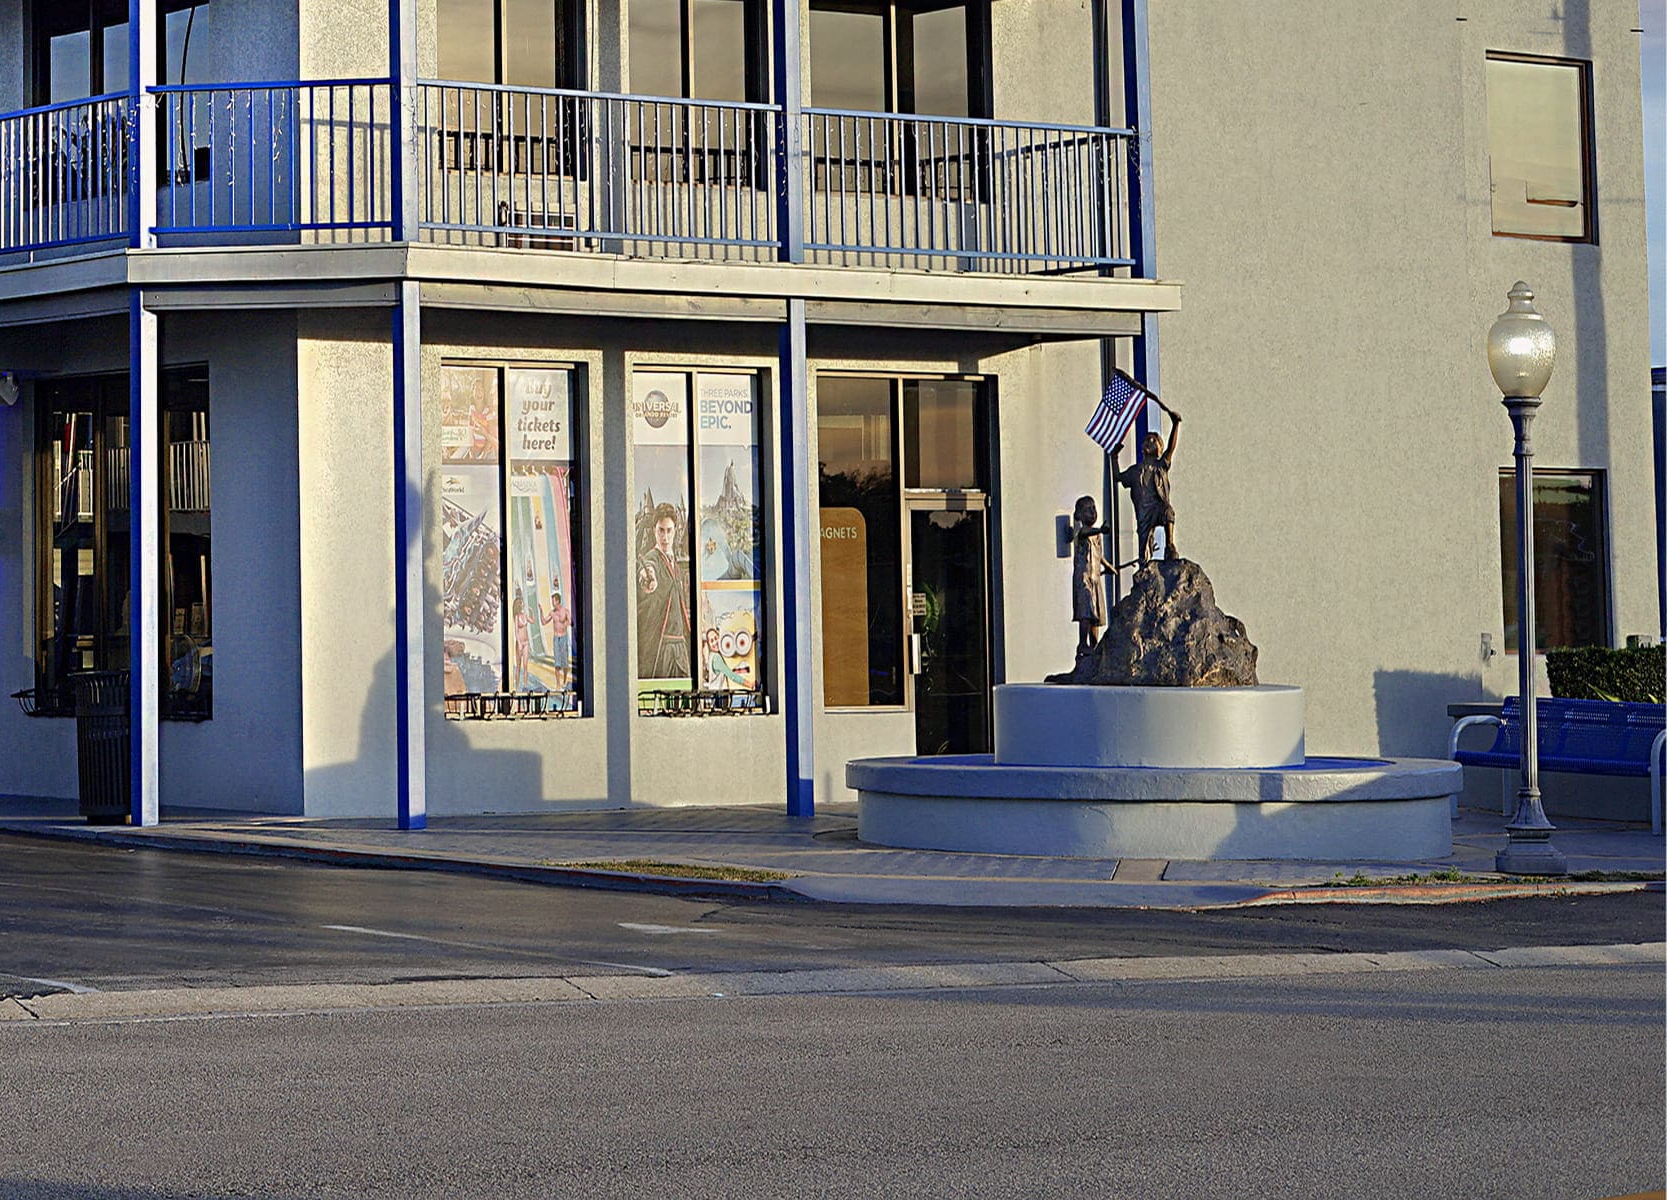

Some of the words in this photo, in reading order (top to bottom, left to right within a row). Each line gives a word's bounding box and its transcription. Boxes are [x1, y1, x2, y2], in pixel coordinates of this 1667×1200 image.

[522, 400, 555, 415] your
[632, 401, 680, 413] UNIVERSAL
[699, 400, 753, 414] BEYOND
[517, 416, 561, 432] tickets
[700, 416, 732, 430] EPIC.
[522, 434, 556, 450] here!
